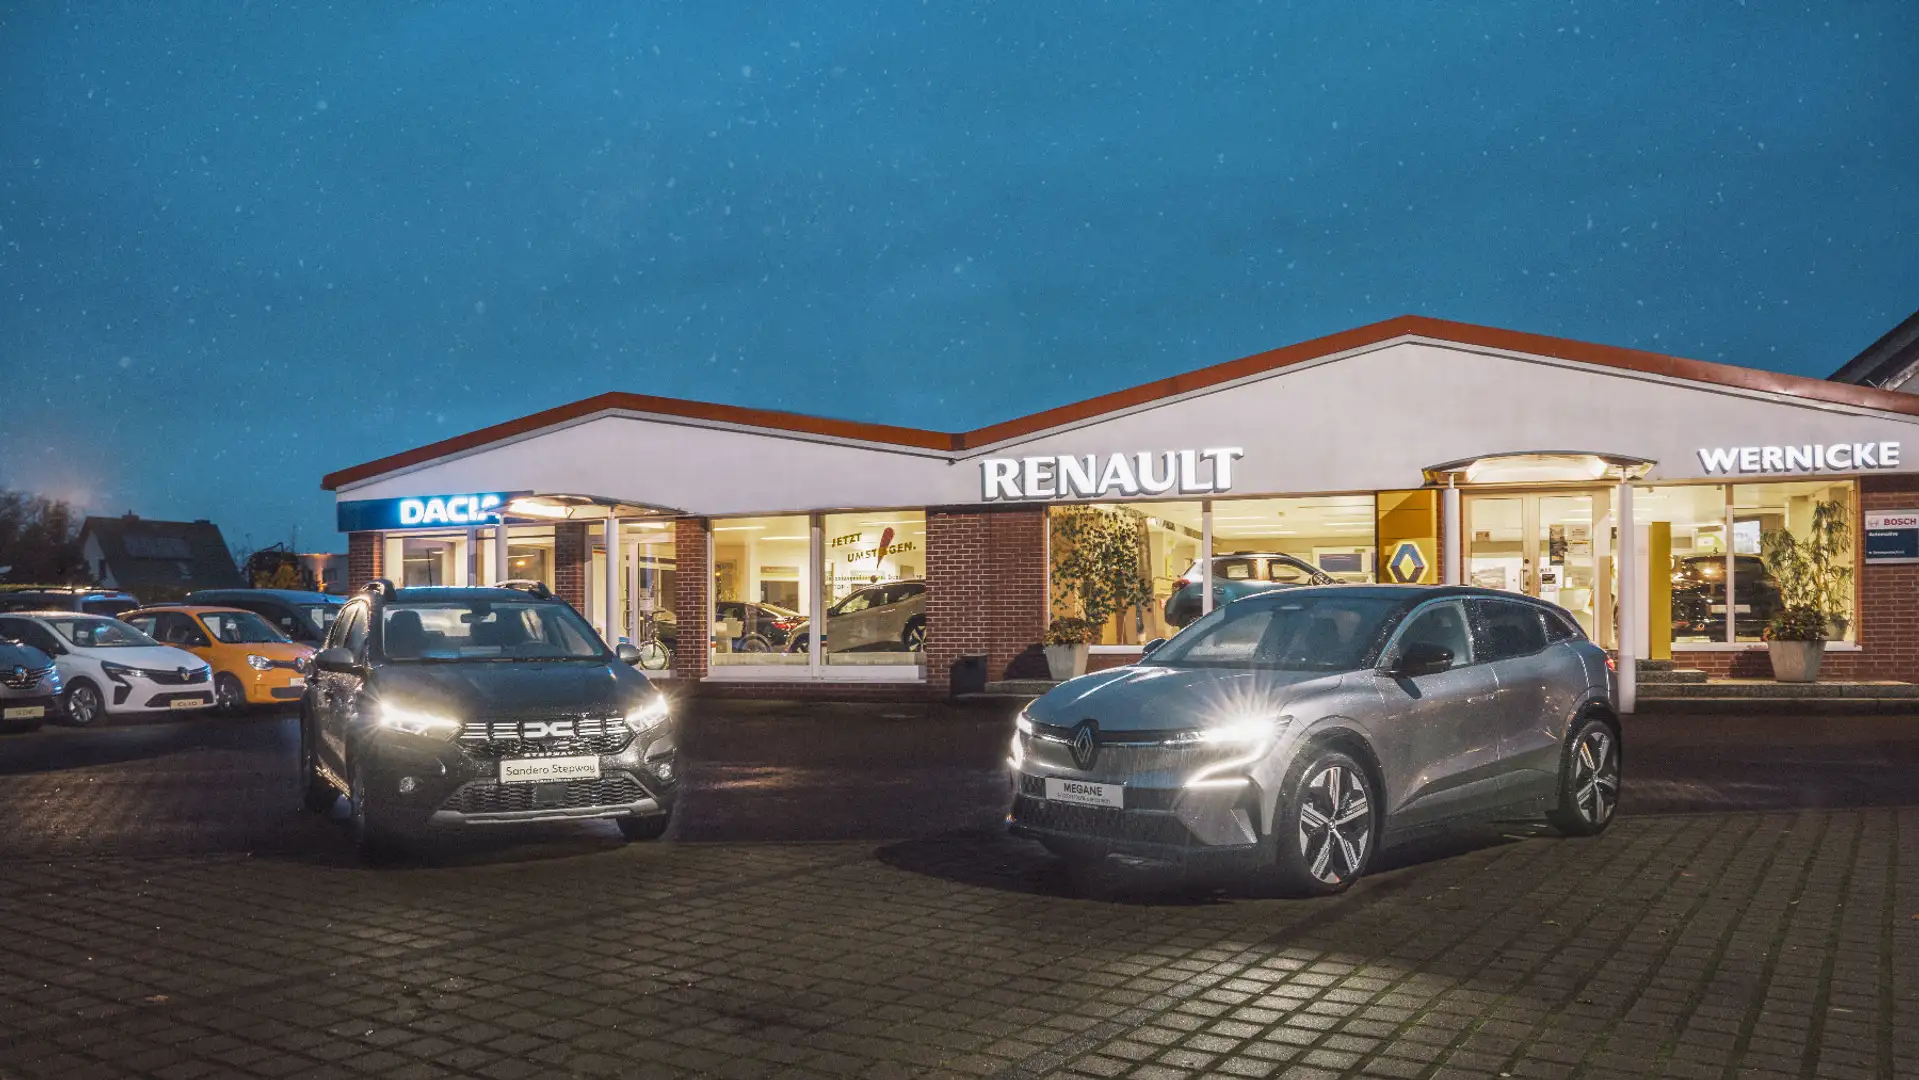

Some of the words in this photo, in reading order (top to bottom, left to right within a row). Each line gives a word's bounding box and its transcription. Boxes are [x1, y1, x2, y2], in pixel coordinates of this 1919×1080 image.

[1697, 442, 1900, 474] WERNICKE
[982, 447, 1243, 500] RENAULT
[1883, 518, 1917, 526] BOSCH
[831, 532, 862, 548] JETZT
[847, 542, 916, 562] UMSTGEN.
[506, 766, 549, 776] Sandero
[552, 764, 595, 774] Stepway
[1063, 782, 1103, 797] MEGANE
